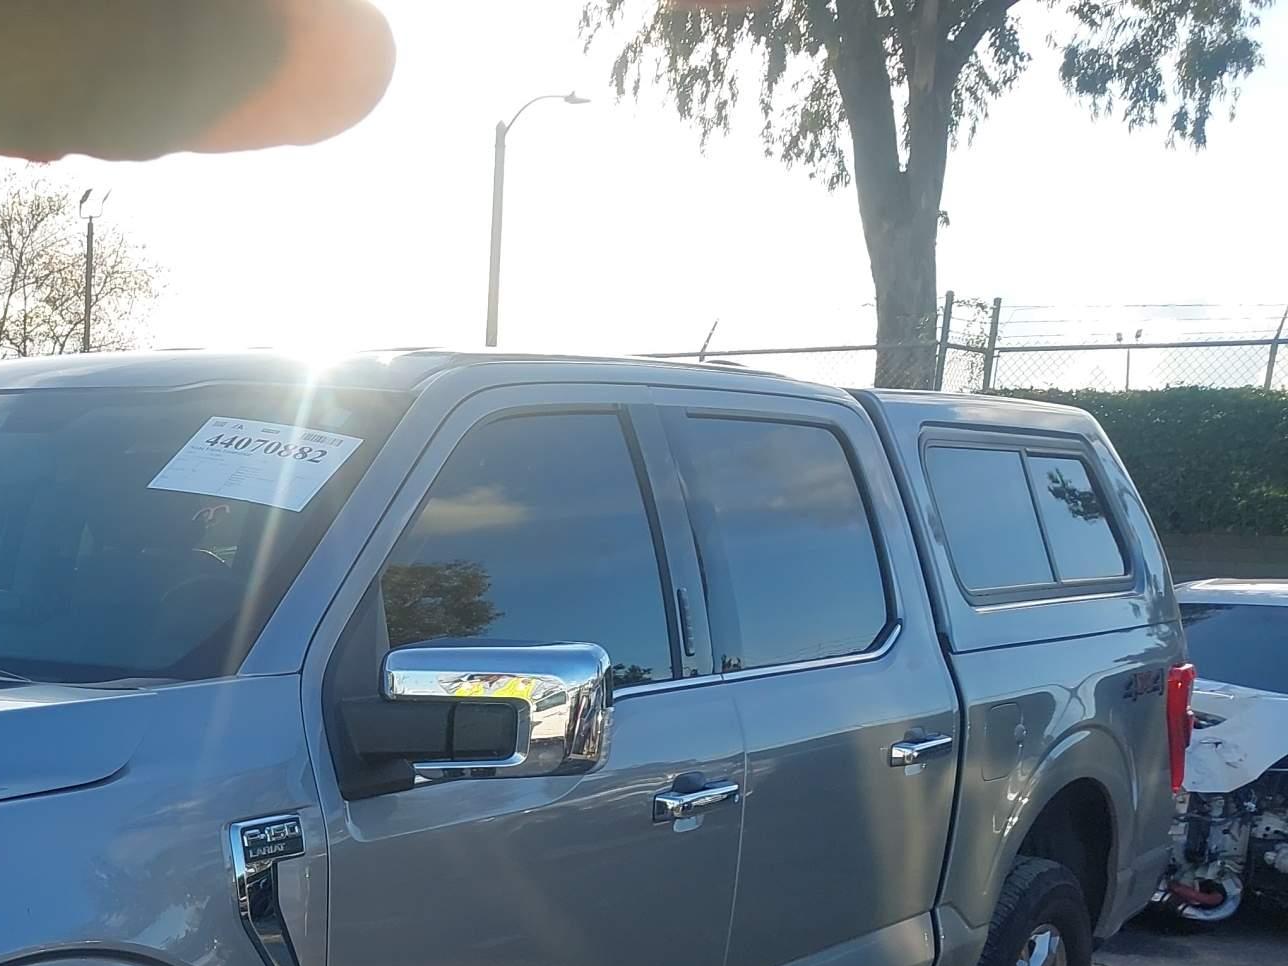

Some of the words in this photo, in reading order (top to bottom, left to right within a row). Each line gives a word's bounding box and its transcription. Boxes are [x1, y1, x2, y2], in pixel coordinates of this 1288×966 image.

[205, 433, 328, 464] 44070882
[243, 821, 300, 847] F-150
[249, 842, 288, 858] LARIAT
